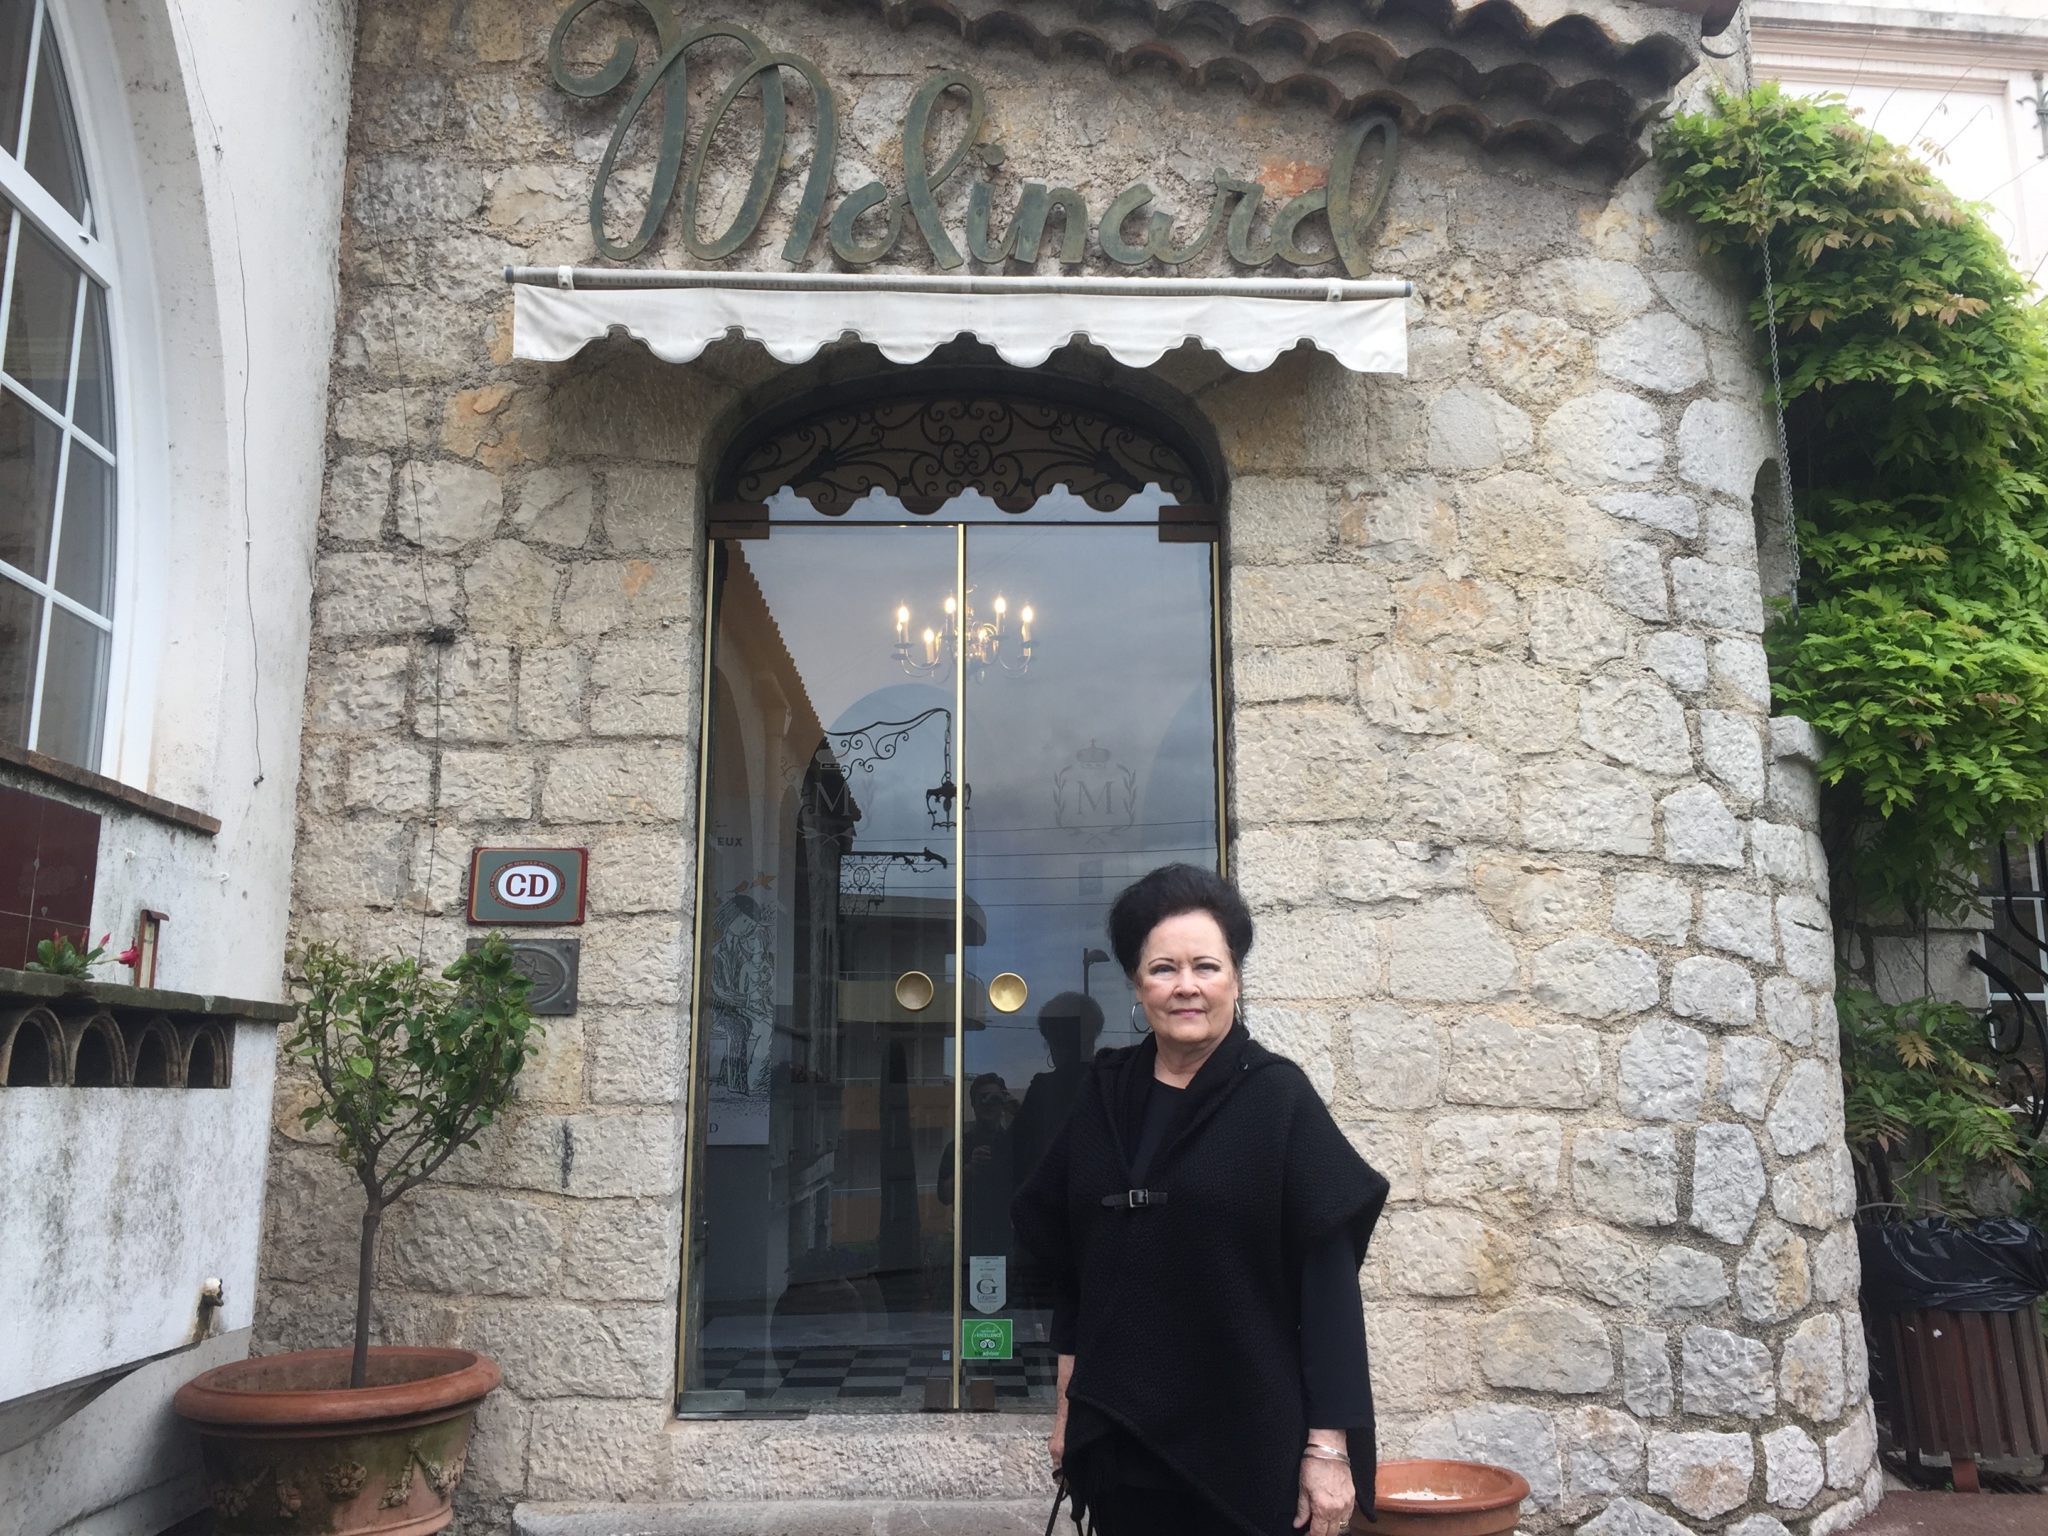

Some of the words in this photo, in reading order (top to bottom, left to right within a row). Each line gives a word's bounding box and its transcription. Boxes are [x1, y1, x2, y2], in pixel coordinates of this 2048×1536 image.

[548, 0, 1398, 278] Molinard
[813, 782, 851, 816] M
[1076, 780, 1115, 815] M
[505, 873, 549, 897] CD
[976, 1278, 999, 1295] G
